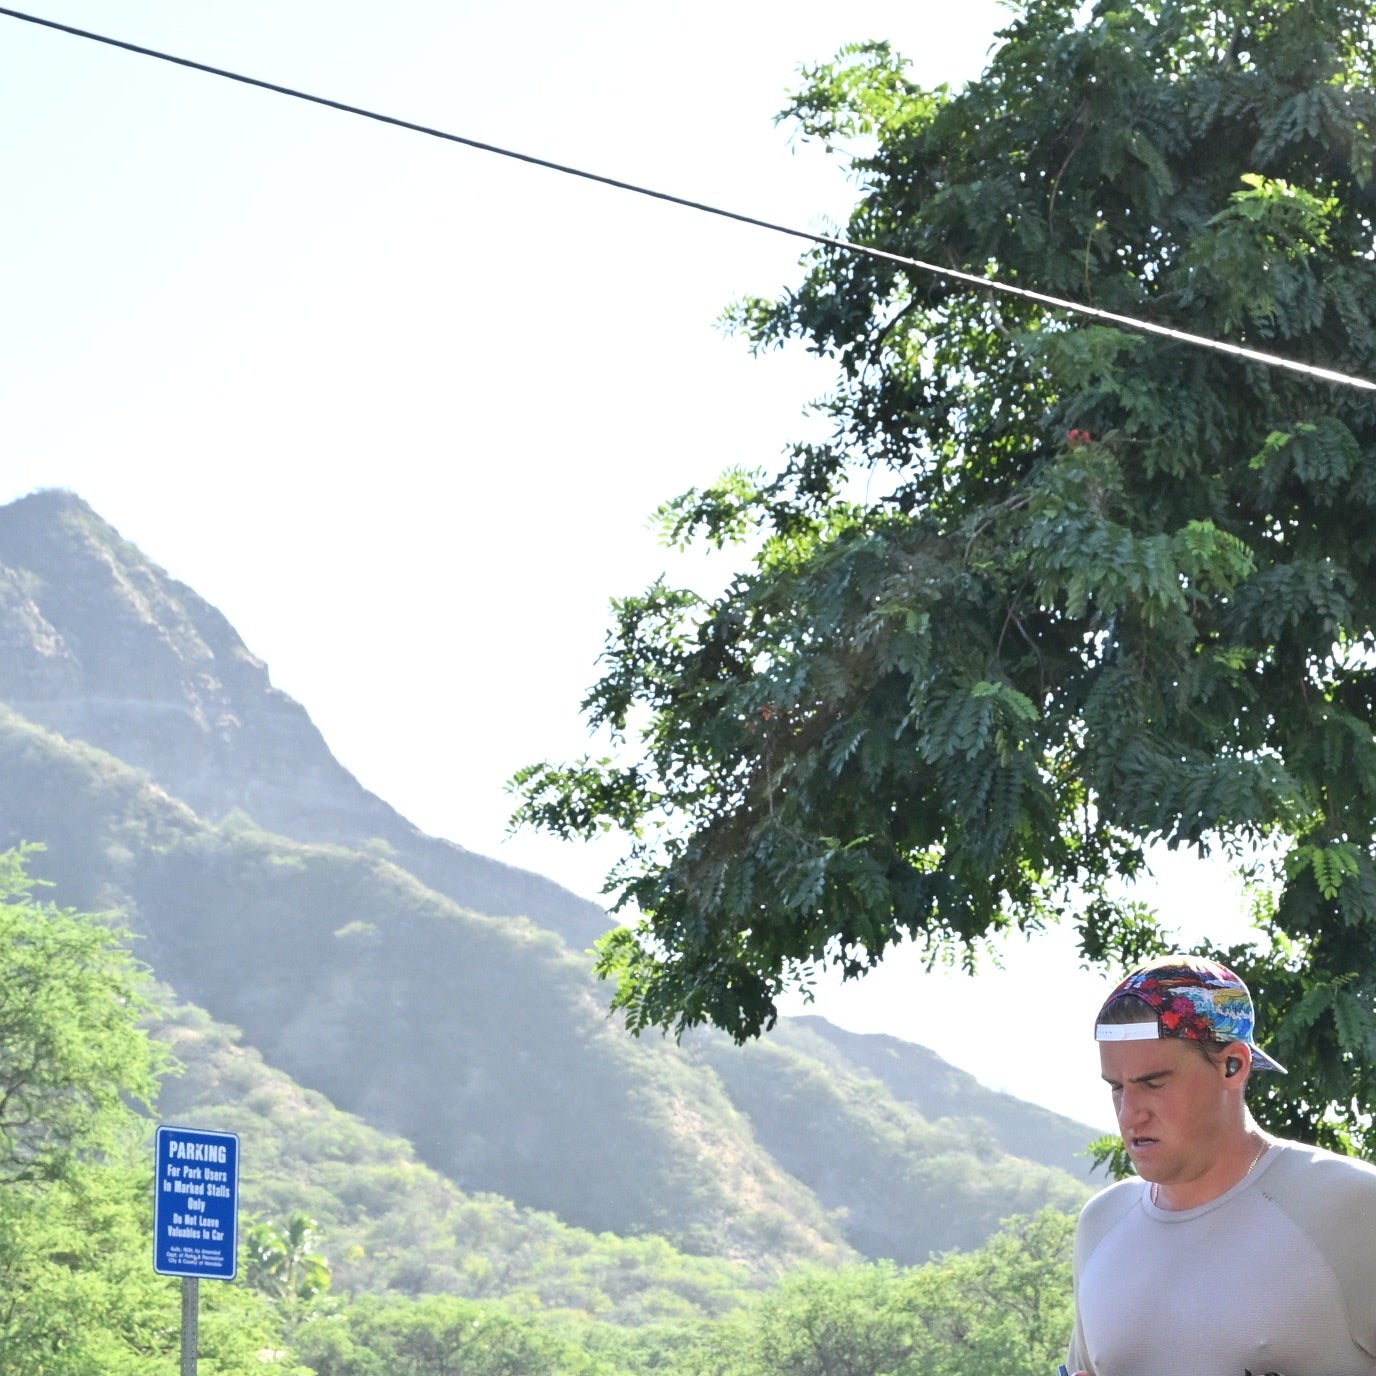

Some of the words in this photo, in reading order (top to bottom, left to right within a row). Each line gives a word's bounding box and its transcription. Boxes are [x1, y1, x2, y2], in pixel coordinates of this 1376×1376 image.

[169, 1141, 226, 1163] PARKING
[167, 1164, 181, 1177] For
[183, 1165, 202, 1179] Park
[204, 1167, 227, 1182] Users
[163, 1179, 172, 1192] In
[174, 1180, 204, 1195] Marked
[207, 1183, 230, 1198] Stalls
[187, 1197, 205, 1213] Only
[173, 1213, 182, 1225] Do
[184, 1214, 197, 1226] Not
[199, 1215, 219, 1228] Leave
[167, 1225, 200, 1239] Valuables
[212, 1229, 224, 1241] Car
